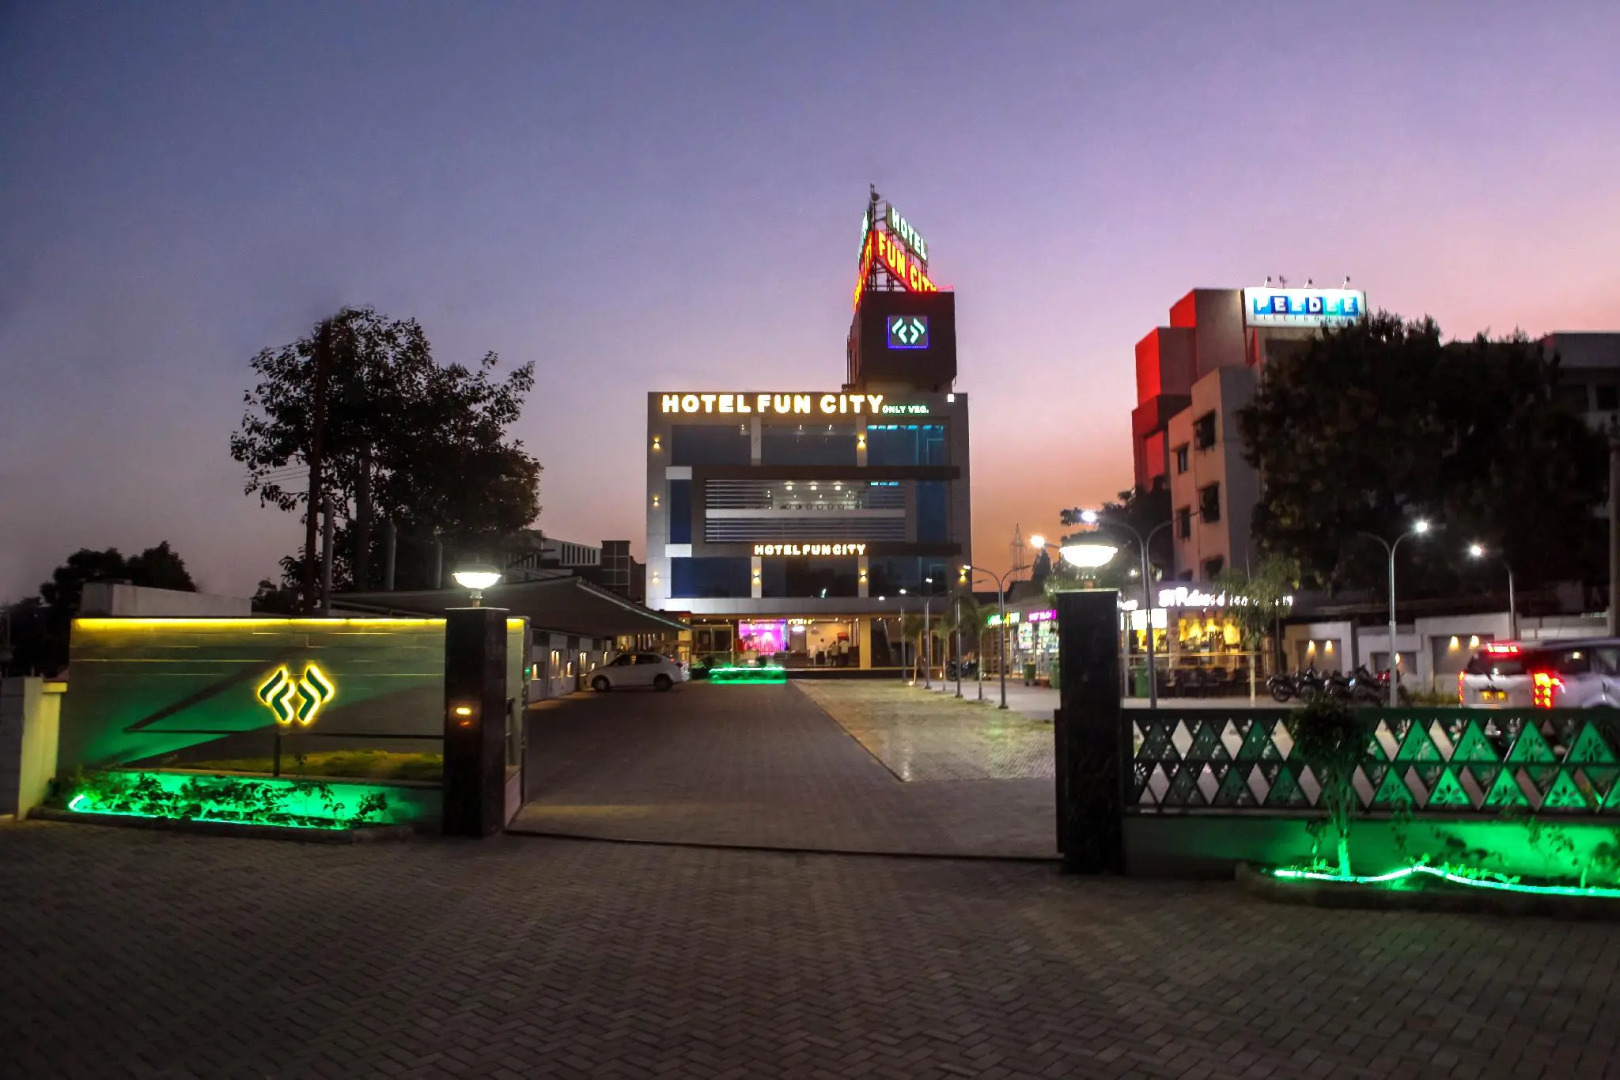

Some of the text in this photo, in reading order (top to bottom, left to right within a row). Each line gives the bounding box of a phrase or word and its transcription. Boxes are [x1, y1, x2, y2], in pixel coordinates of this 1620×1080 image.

[891, 206, 927, 260] HOTEL
[878, 230, 906, 279] FUN
[662, 394, 884, 414] HOTEL FUN CITY
[882, 405, 906, 414] ONLY
[754, 544, 801, 555] HOTEL
